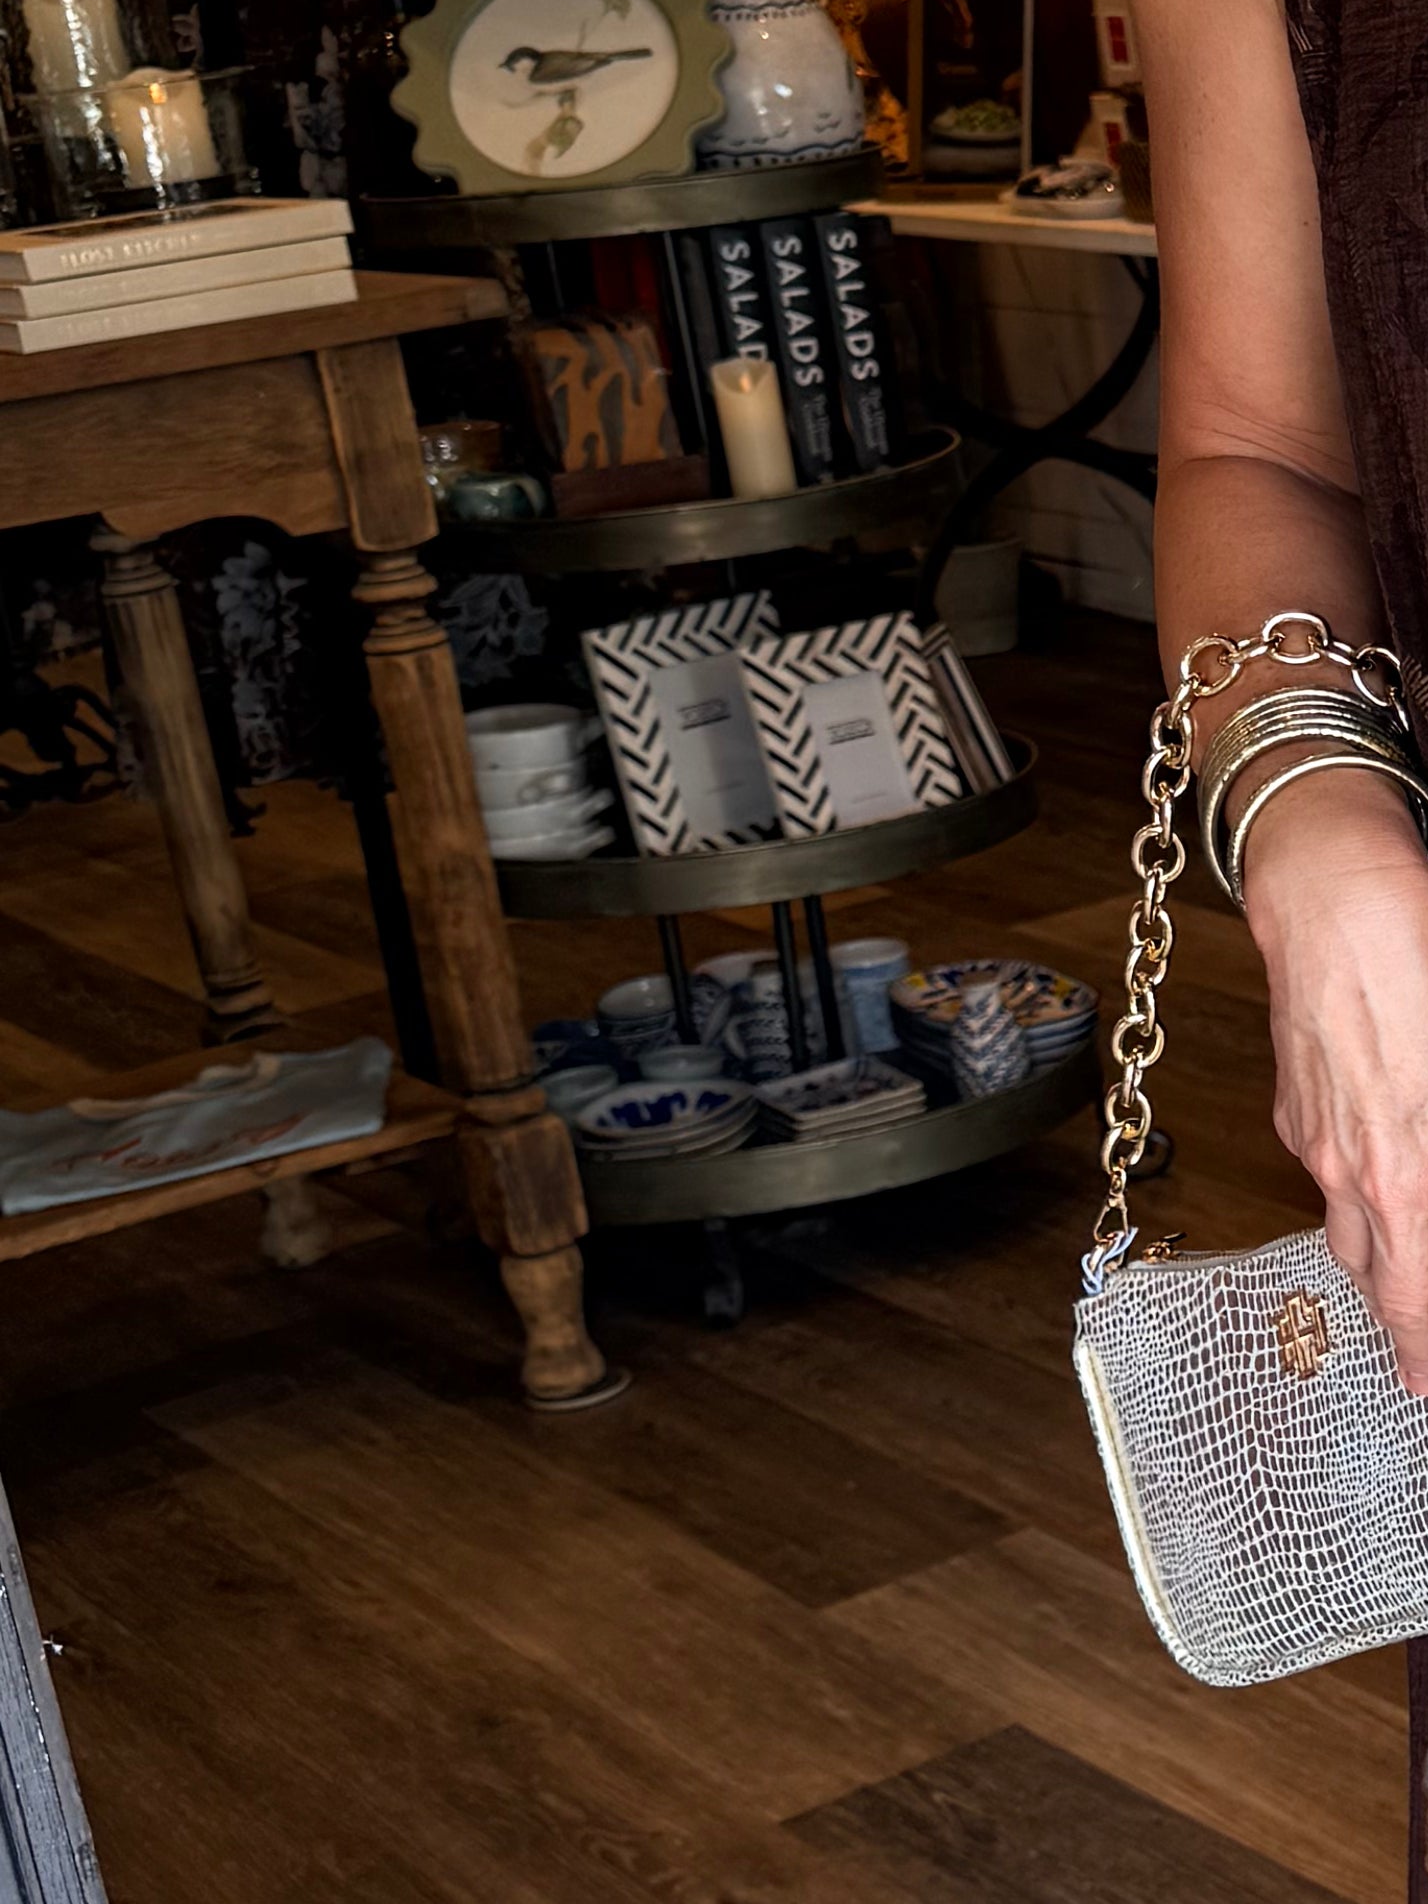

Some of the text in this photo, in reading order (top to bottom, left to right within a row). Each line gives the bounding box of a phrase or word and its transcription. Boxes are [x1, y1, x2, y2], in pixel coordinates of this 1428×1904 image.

[720, 239, 768, 363] SALAD
[772, 234, 824, 387] SALADS
[828, 228, 880, 381] SALADS
